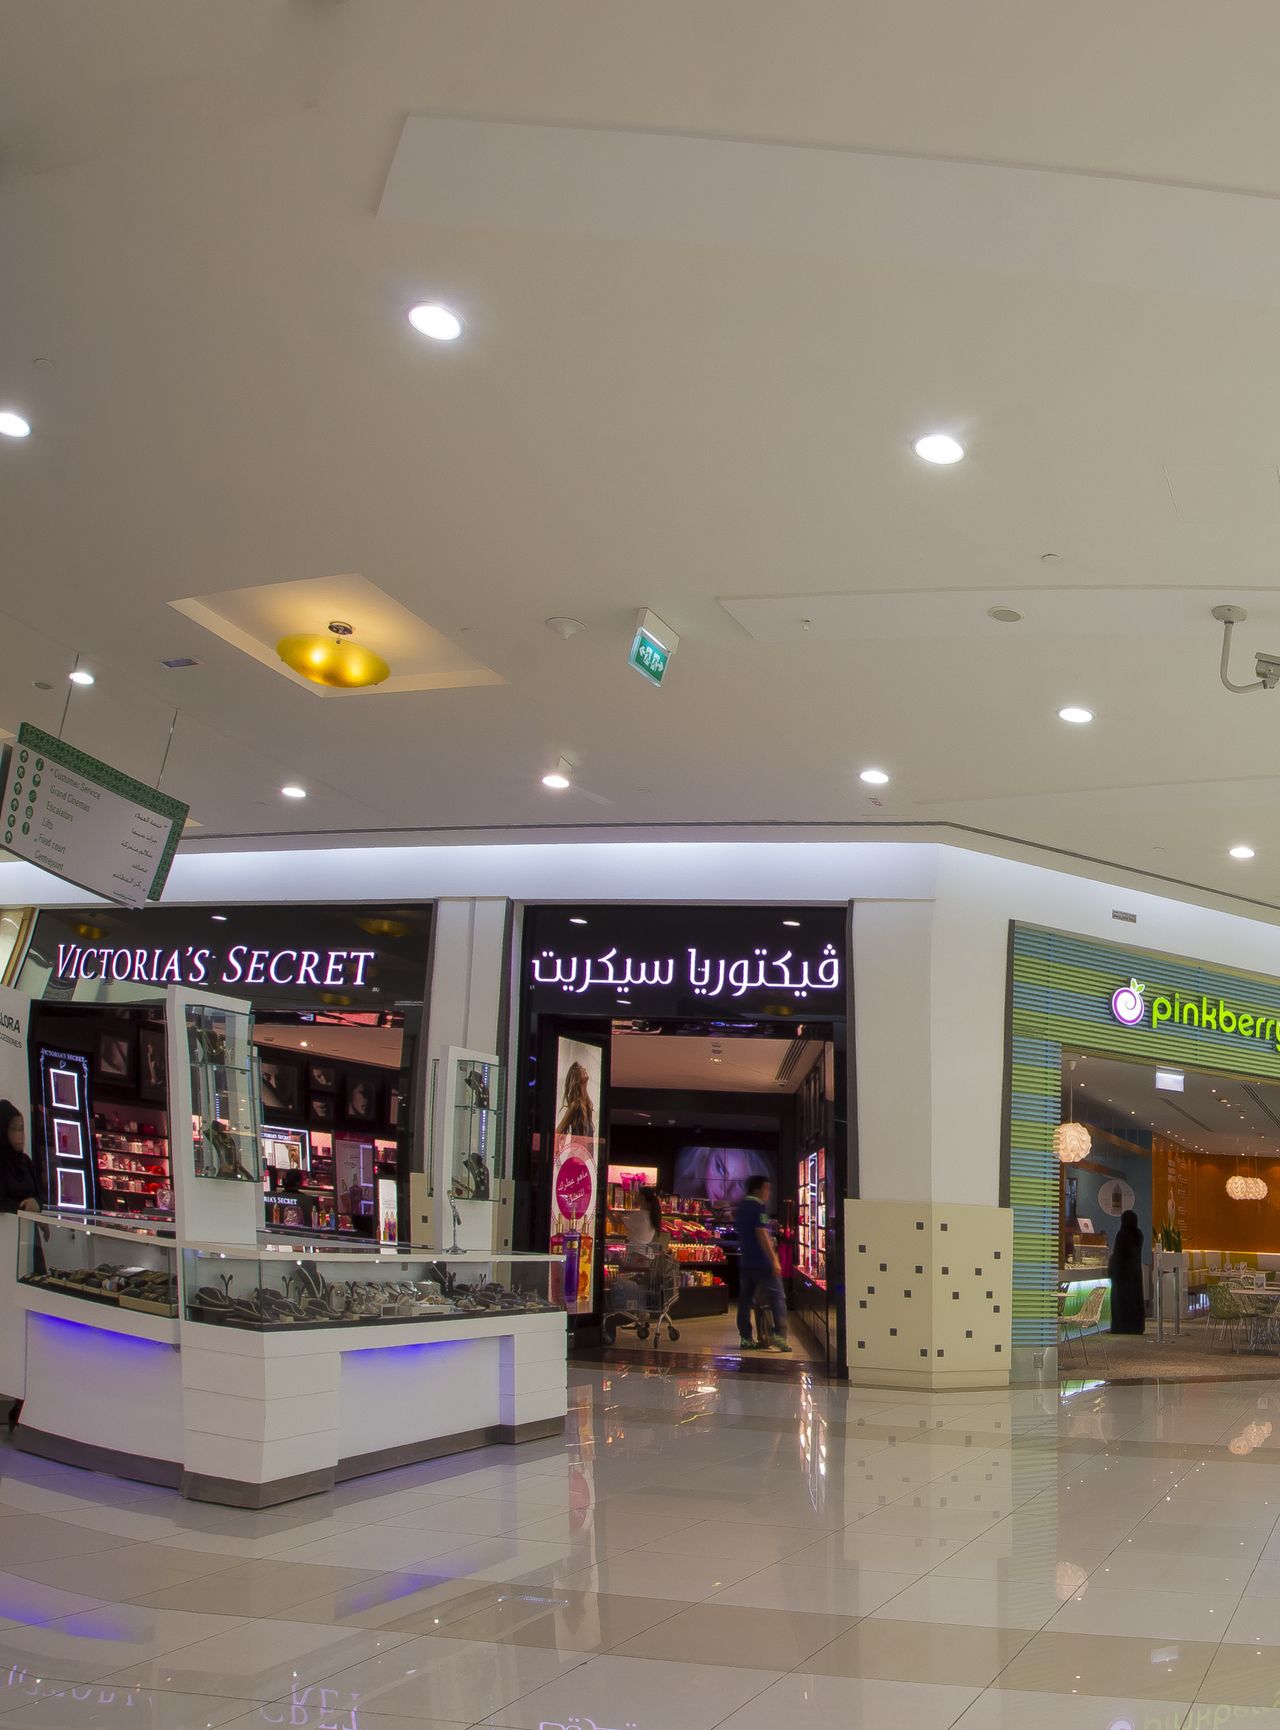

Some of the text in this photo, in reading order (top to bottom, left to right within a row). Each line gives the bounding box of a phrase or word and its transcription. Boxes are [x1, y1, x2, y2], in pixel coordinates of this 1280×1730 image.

[53, 768, 101, 800] Customer Service
[50, 784, 91, 812] Grand Cinemas
[42, 817, 54, 831] Lifts
[46, 800, 74, 823] Escalators
[38, 833, 66, 855] Food court
[34, 849, 65, 872] Centrepoint
[56, 944, 375, 986] VICTORIA'S SECRET
[532, 947, 675, 993] سيكريت
